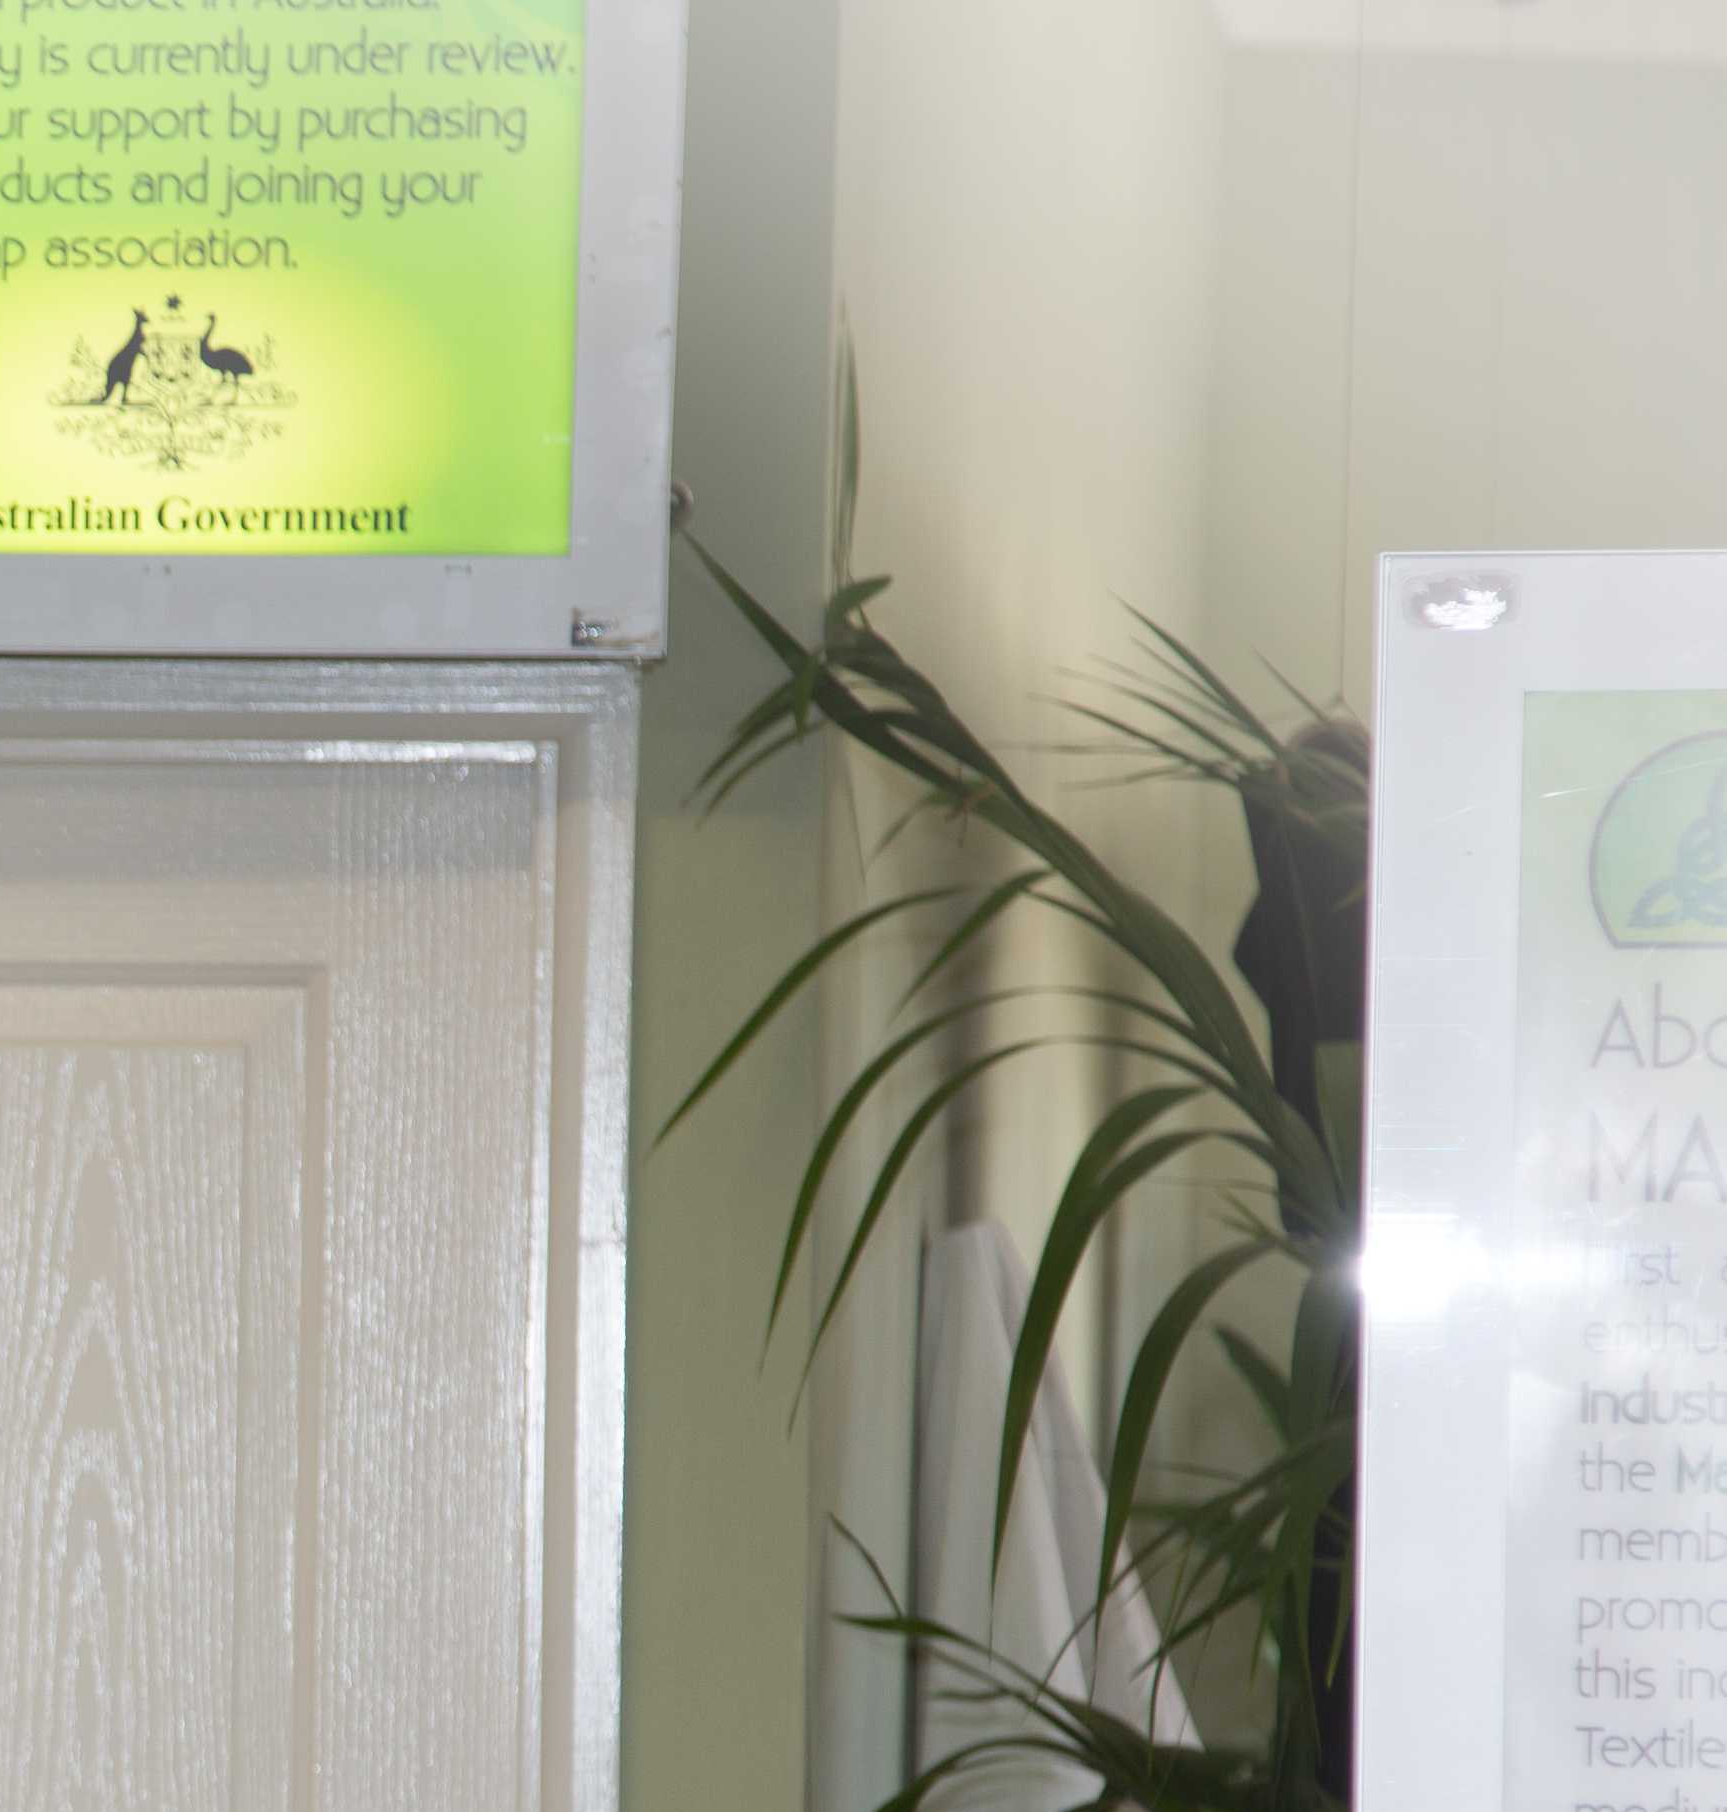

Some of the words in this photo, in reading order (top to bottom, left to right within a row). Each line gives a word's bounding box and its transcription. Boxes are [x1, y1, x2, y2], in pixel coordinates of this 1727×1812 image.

[39, 34, 70, 77] is
[85, 34, 270, 86] currently
[287, 34, 408, 77] under
[425, 34, 577, 77] review.
[47, 104, 209, 152] support
[227, 98, 281, 152] by
[295, 100, 527, 154] purchasing
[131, 160, 209, 205] and
[219, 162, 363, 217] joining
[379, 166, 481, 217] your
[43, 225, 299, 272] association.
[156, 498, 412, 536] Government
[1575, 1651, 1657, 1701] this
